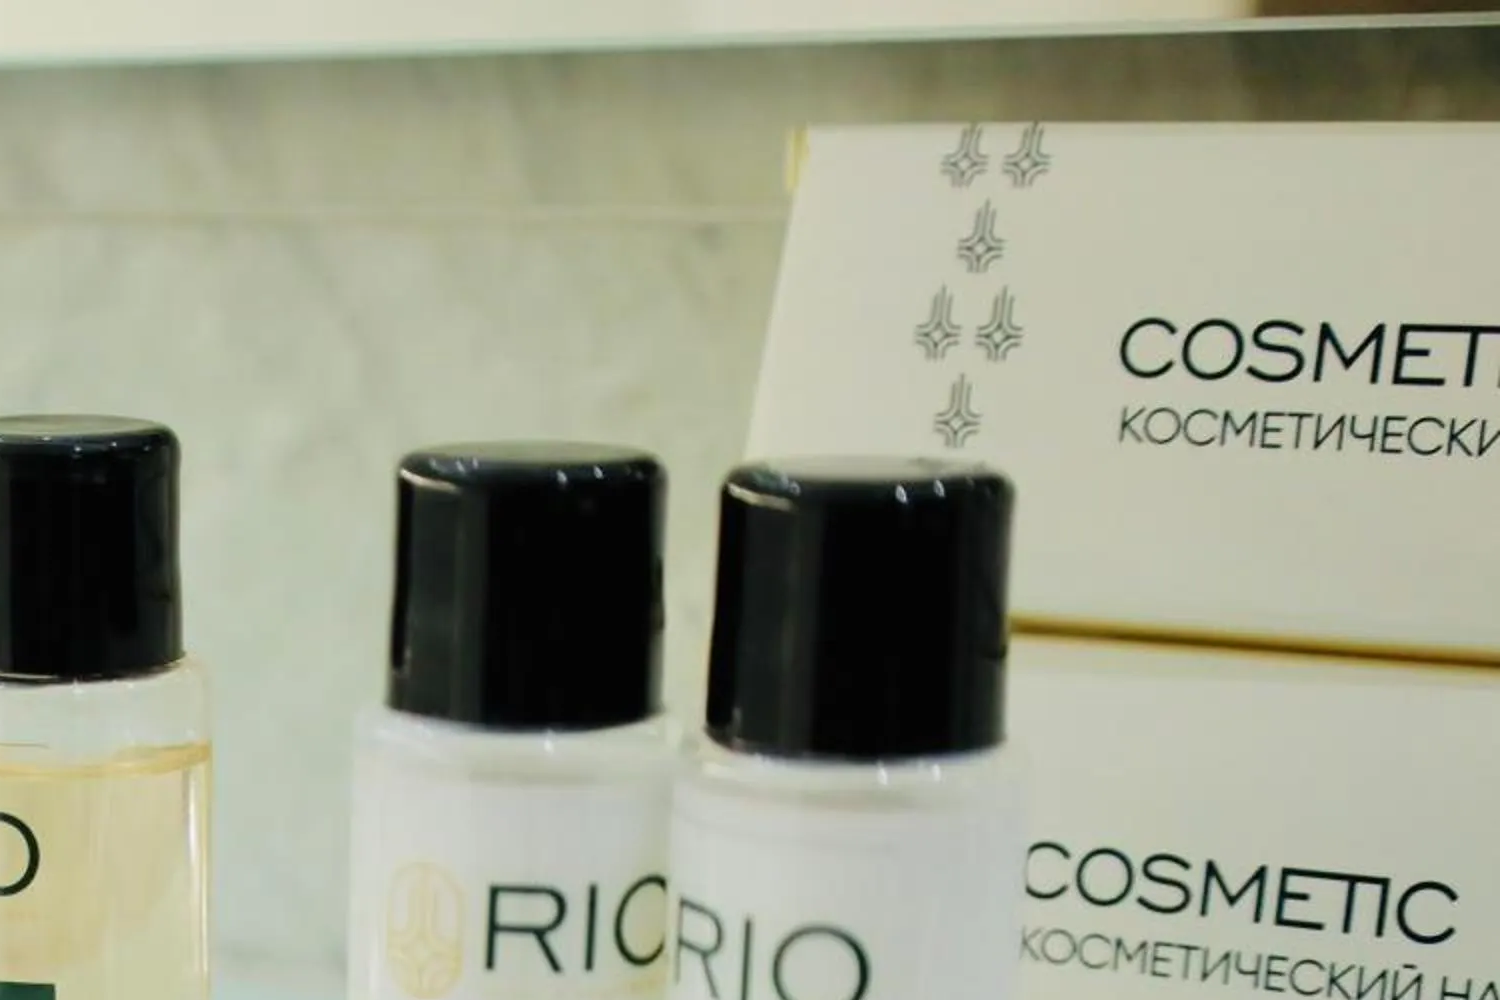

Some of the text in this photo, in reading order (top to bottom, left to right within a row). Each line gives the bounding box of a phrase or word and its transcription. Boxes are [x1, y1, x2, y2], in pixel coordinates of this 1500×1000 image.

[1119, 317, 1500, 388] COSMET
[484, 874, 667, 973] RIO
[1024, 841, 1459, 945] COSMETIC
